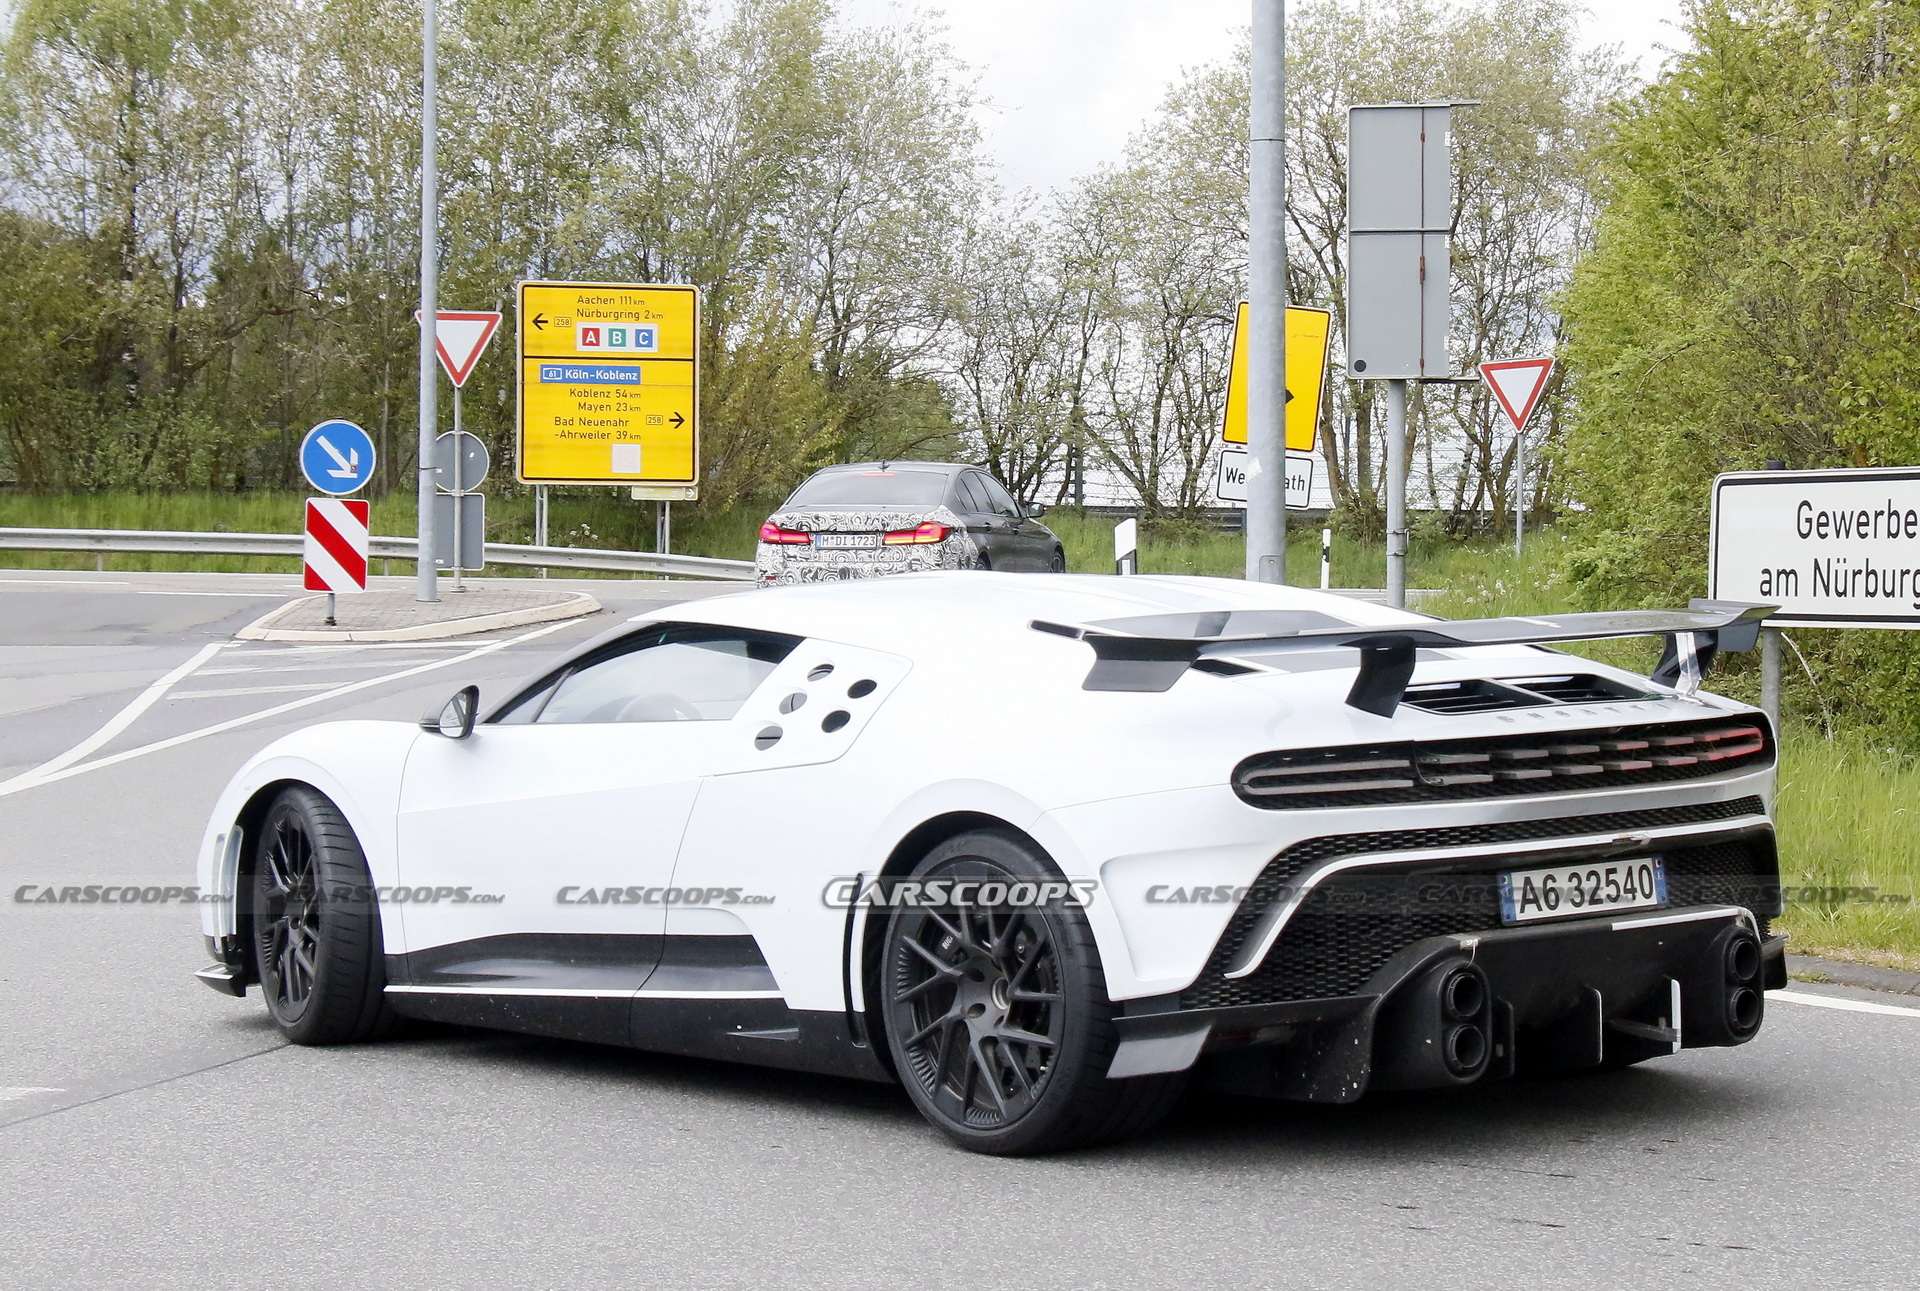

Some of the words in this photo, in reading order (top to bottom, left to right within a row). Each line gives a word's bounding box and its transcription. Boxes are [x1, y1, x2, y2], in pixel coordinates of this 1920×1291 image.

[577, 295, 615, 305] Aachen
[576, 309, 640, 321] Nürburgring
[644, 310, 650, 320] 2
[652, 312, 664, 320] km
[585, 331, 597, 344] A
[612, 331, 622, 344] B
[639, 332, 649, 345] C
[548, 369, 557, 378] 61
[570, 388, 611, 398] Koblenz
[615, 389, 628, 399] 54
[578, 402, 611, 413] Mayen
[616, 403, 628, 412] 23
[554, 417, 574, 426] Bad
[579, 417, 629, 427] Neuenahr
[647, 416, 662, 424] 258
[555, 430, 612, 439] -Ahrweiler
[616, 430, 628, 440] 39
[1796, 499, 1919, 540] Gewerbe
[851, 536, 876, 546] 1723
[1759, 567, 1799, 597] am
[1519, 874, 1560, 914] A6
[1567, 864, 1654, 908] 32540
